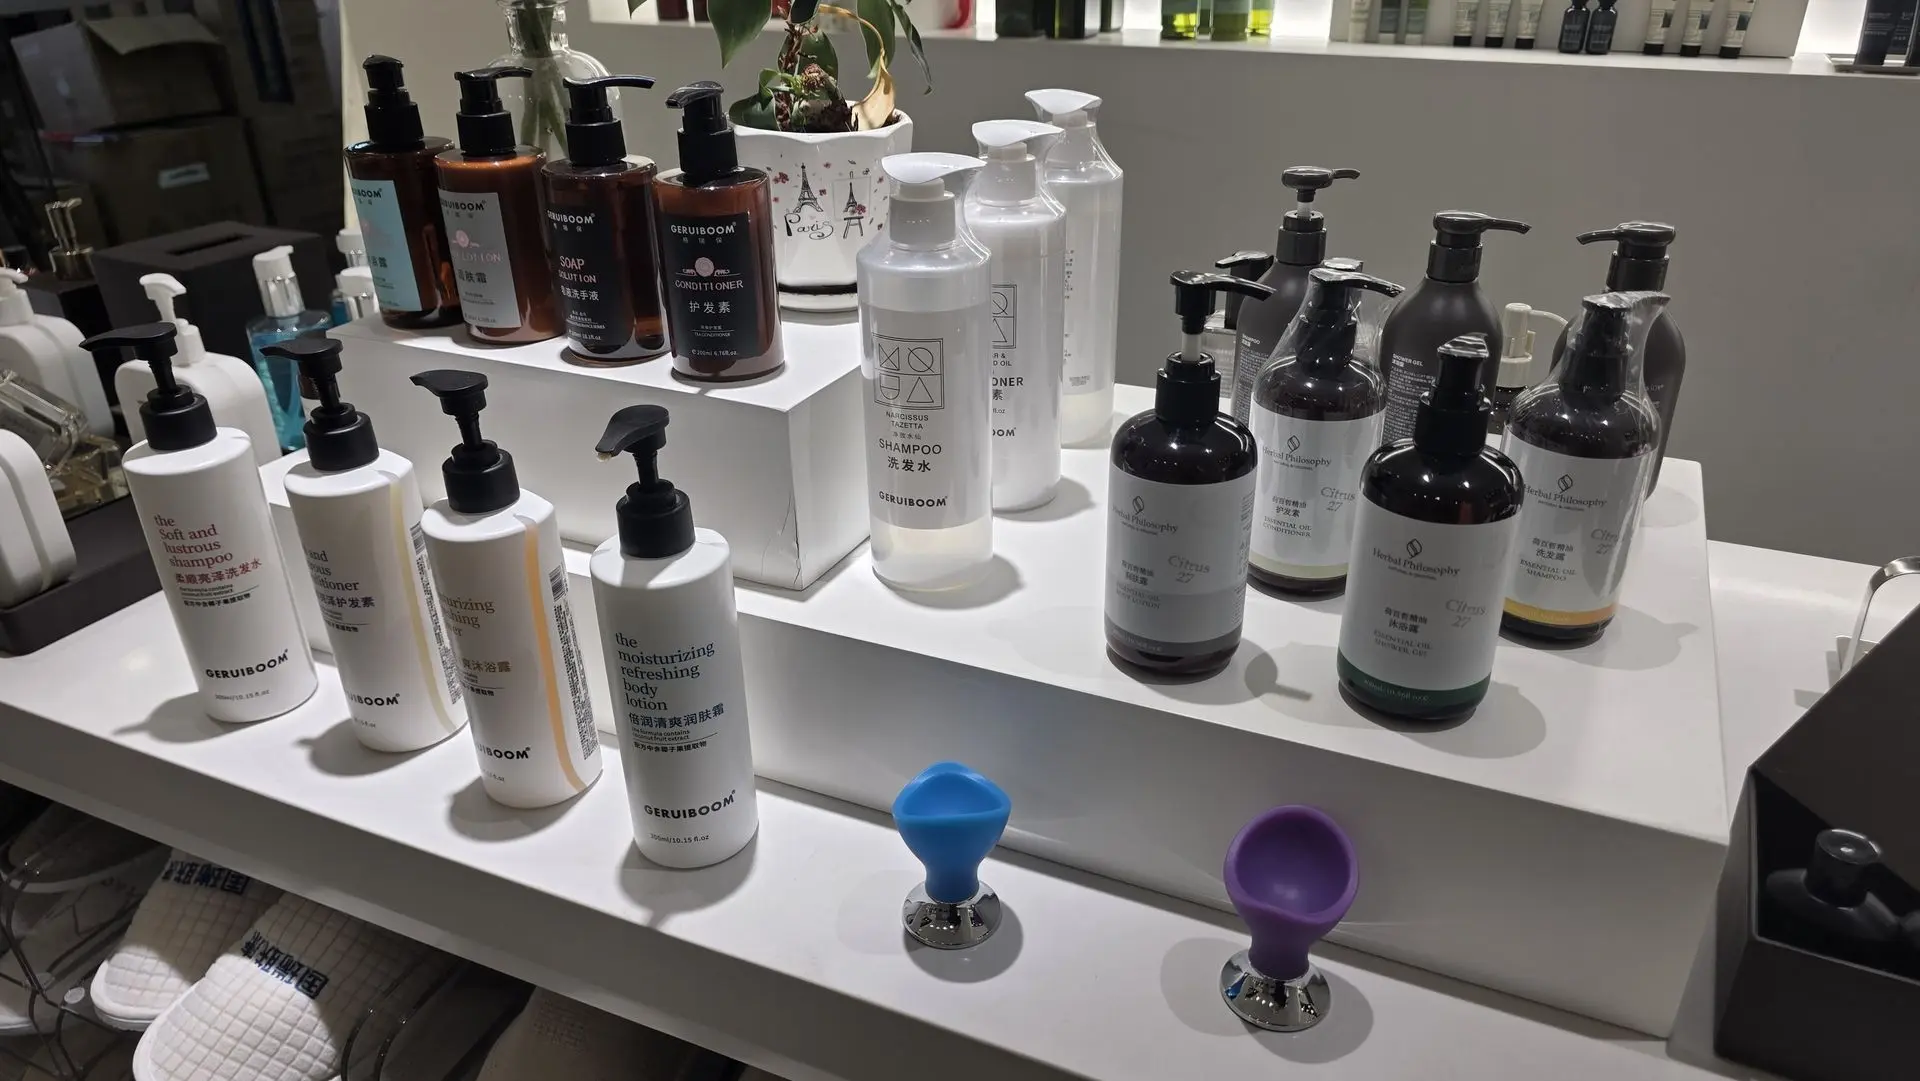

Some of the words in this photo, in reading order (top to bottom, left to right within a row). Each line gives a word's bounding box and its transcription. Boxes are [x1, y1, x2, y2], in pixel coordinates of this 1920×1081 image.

[670, 224, 735, 235] GERUIBOOM
[784, 213, 834, 240] Paris
[560, 255, 585, 270] SOAP
[558, 269, 597, 283] SOLUTION
[674, 280, 744, 291] CONDITIONER
[689, 301, 731, 314] 护发素
[992, 377, 1024, 386] ONER
[885, 411, 929, 421] NARCISSUS
[891, 420, 923, 429] TAZETTA
[878, 438, 942, 455] SHAMPOO
[888, 455, 931, 472] 洗发水
[1263, 446, 1283, 459] Herbal
[1285, 453, 1331, 467] Philosophy
[878, 491, 946, 507] GERUIBOOM
[1321, 486, 1356, 501] Citrus
[1525, 484, 1551, 501] Herbal
[1554, 493, 1607, 509] Philosophy
[1326, 501, 1343, 512] 27
[154, 513, 175, 527] the
[1131, 515, 1179, 534] Philosophy
[159, 528, 185, 541] Soft
[188, 524, 218, 540] and
[1263, 521, 1311, 538] CONDITIONER
[163, 541, 221, 554] lustrous
[169, 552, 233, 568] shampoo
[1167, 554, 1210, 574] Citrus
[1373, 547, 1401, 566] Herbal
[1403, 559, 1461, 576] Philosophy
[1520, 558, 1560, 574] ESSENTIAL
[1175, 571, 1195, 584] 27
[1526, 568, 1567, 581] SHAMPOO
[446, 597, 495, 614] urizing
[1445, 599, 1487, 616] Citrus
[1452, 615, 1472, 629] 27
[615, 632, 638, 648] the
[617, 642, 715, 665] moisturizing
[205, 653, 288, 678] GERUIBOOM
[620, 664, 700, 681] refreshing
[623, 678, 658, 698] body
[625, 692, 668, 711] lotion
[644, 794, 735, 819] GERUIBOOM
